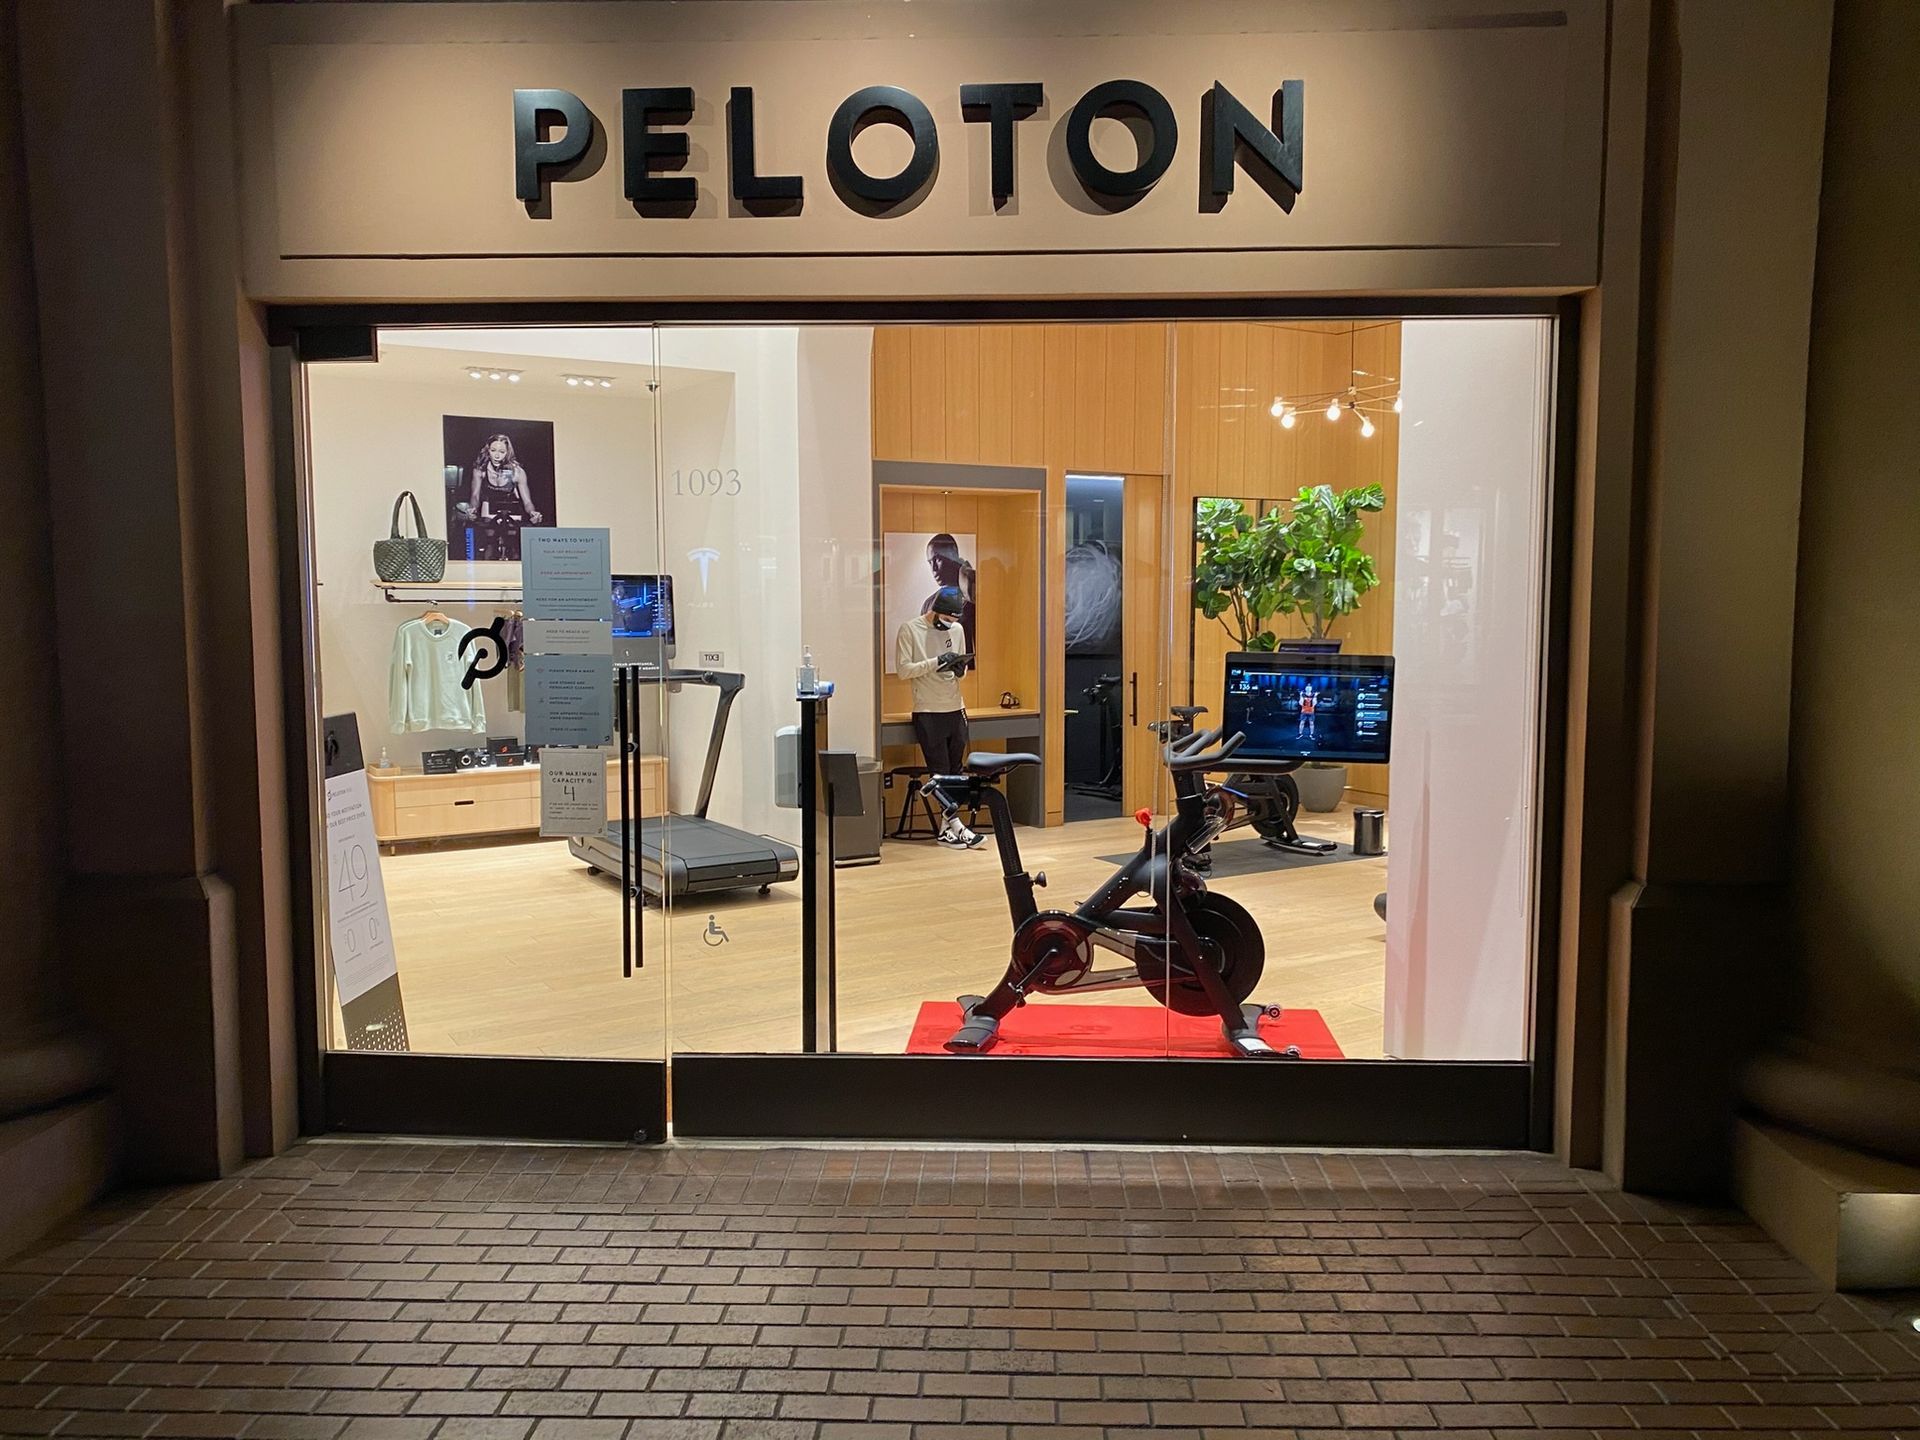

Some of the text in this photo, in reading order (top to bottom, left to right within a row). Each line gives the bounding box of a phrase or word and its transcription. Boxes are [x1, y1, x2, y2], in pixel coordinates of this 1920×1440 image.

[514, 79, 1305, 216] PELOTON
[671, 469, 743, 497] 1093
[564, 785, 575, 801] 4
